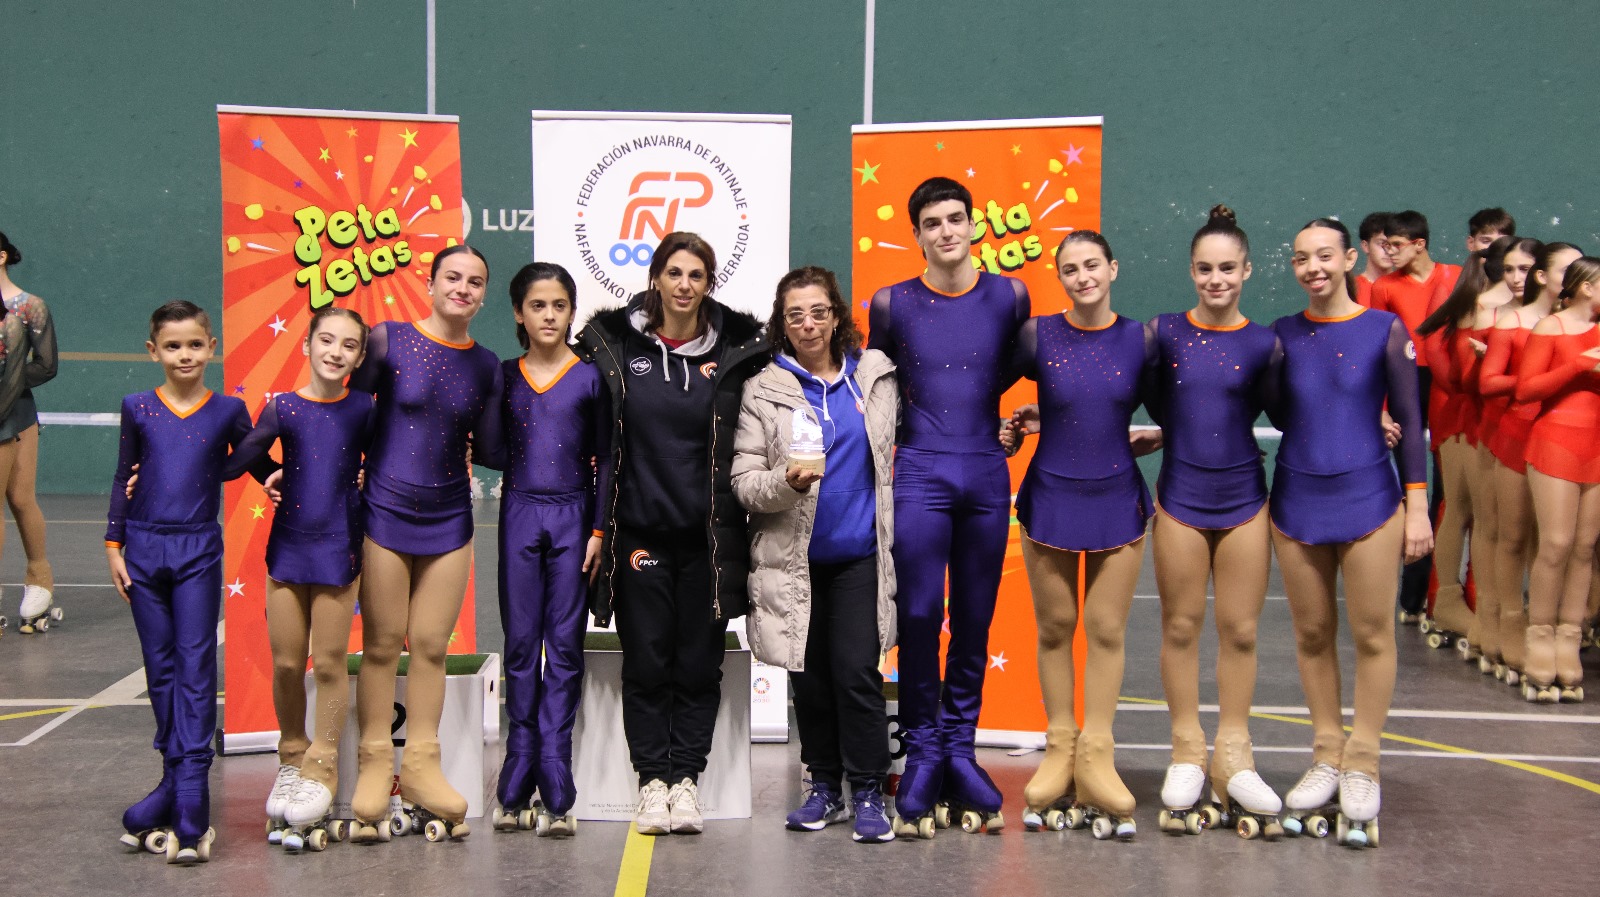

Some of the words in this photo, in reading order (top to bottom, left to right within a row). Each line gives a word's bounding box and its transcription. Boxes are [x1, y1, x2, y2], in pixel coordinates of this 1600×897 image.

[577, 142, 631, 207] FEDERACIÓN
[632, 134, 692, 152] NAVARRA
[693, 144, 712, 161] DE
[709, 155, 748, 211] PATINAJE
[294, 203, 401, 265] Peta
[482, 208, 534, 231] LUZ
[295, 240, 412, 313] Zetas
[574, 223, 626, 299] NAFARROAKO
[711, 223, 750, 296] EDERAZIOA
[887, 714, 908, 761] 3
